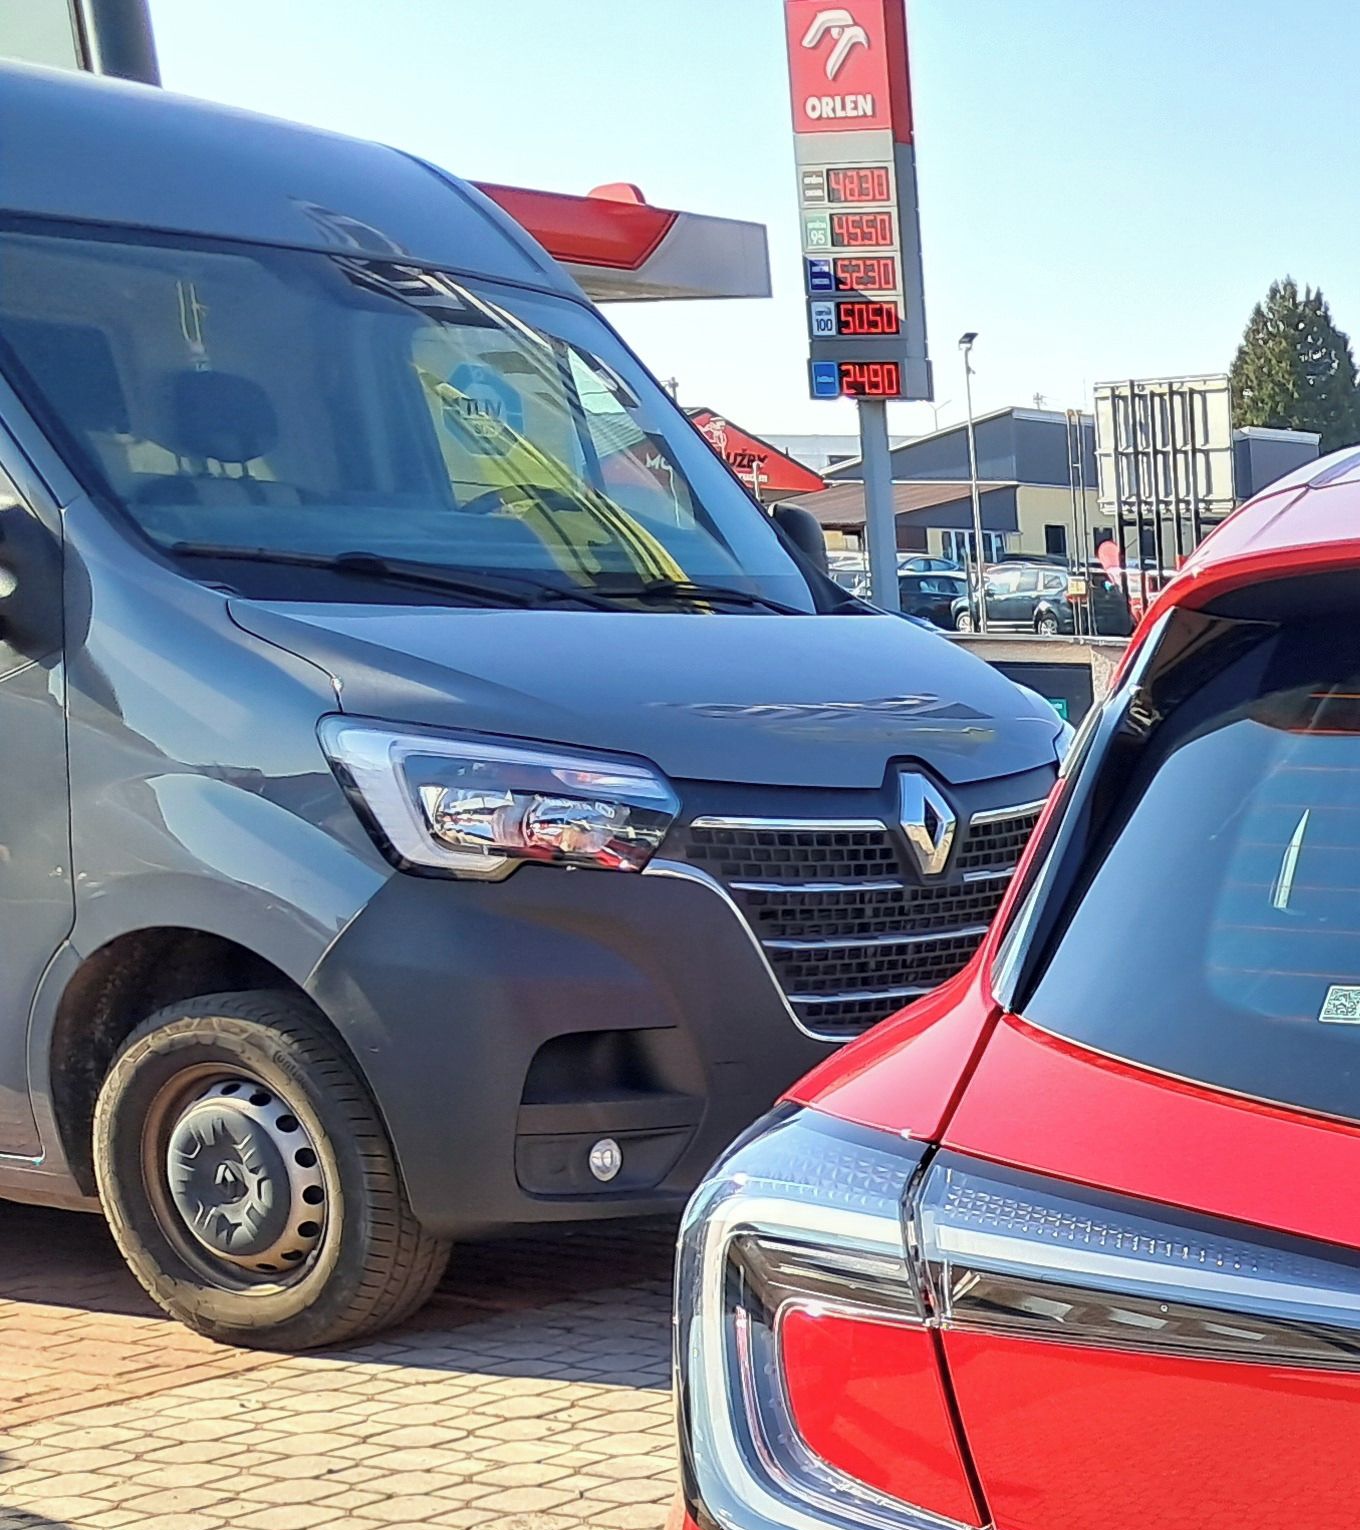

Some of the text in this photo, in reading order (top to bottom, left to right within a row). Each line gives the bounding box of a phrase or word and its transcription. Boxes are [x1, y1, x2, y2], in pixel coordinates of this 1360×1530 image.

[804, 93, 874, 120] ORLEN
[810, 230, 827, 245] 95
[815, 318, 833, 332] 100
